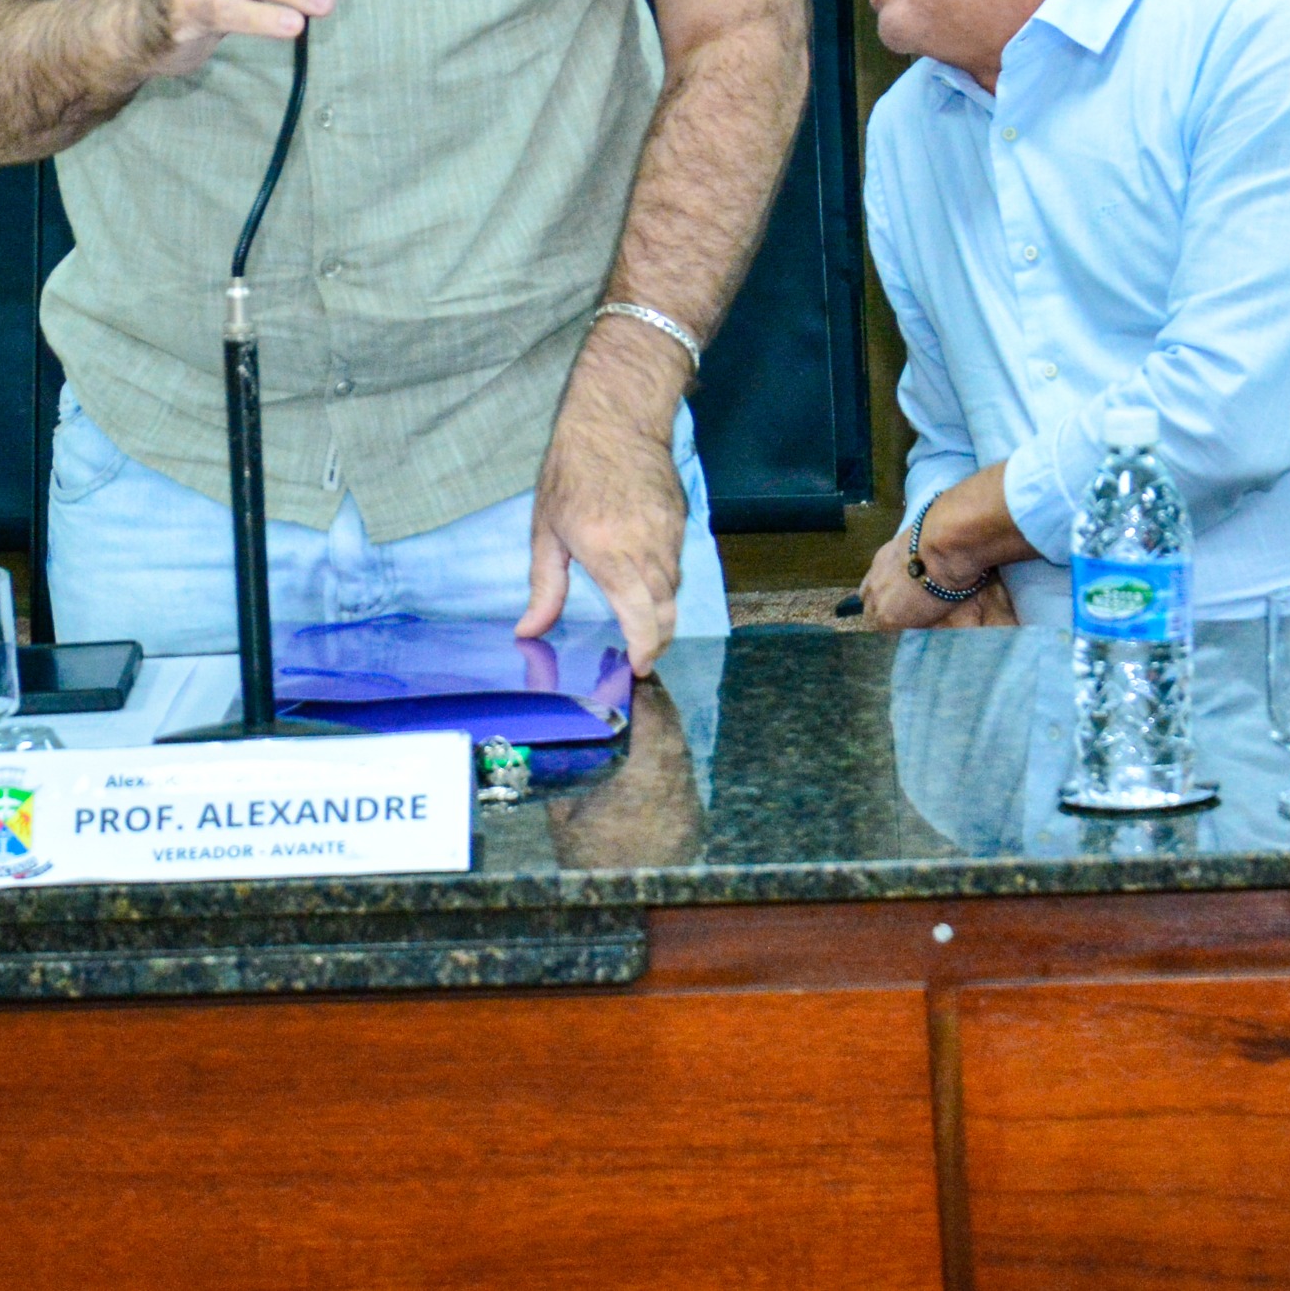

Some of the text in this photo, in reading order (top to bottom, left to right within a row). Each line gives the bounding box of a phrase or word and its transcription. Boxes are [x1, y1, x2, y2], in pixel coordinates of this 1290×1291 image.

[74, 794, 429, 834] PROF. ALEXANDRE
[152, 844, 255, 861] VEREADOR
[270, 840, 347, 857] AVANTE
